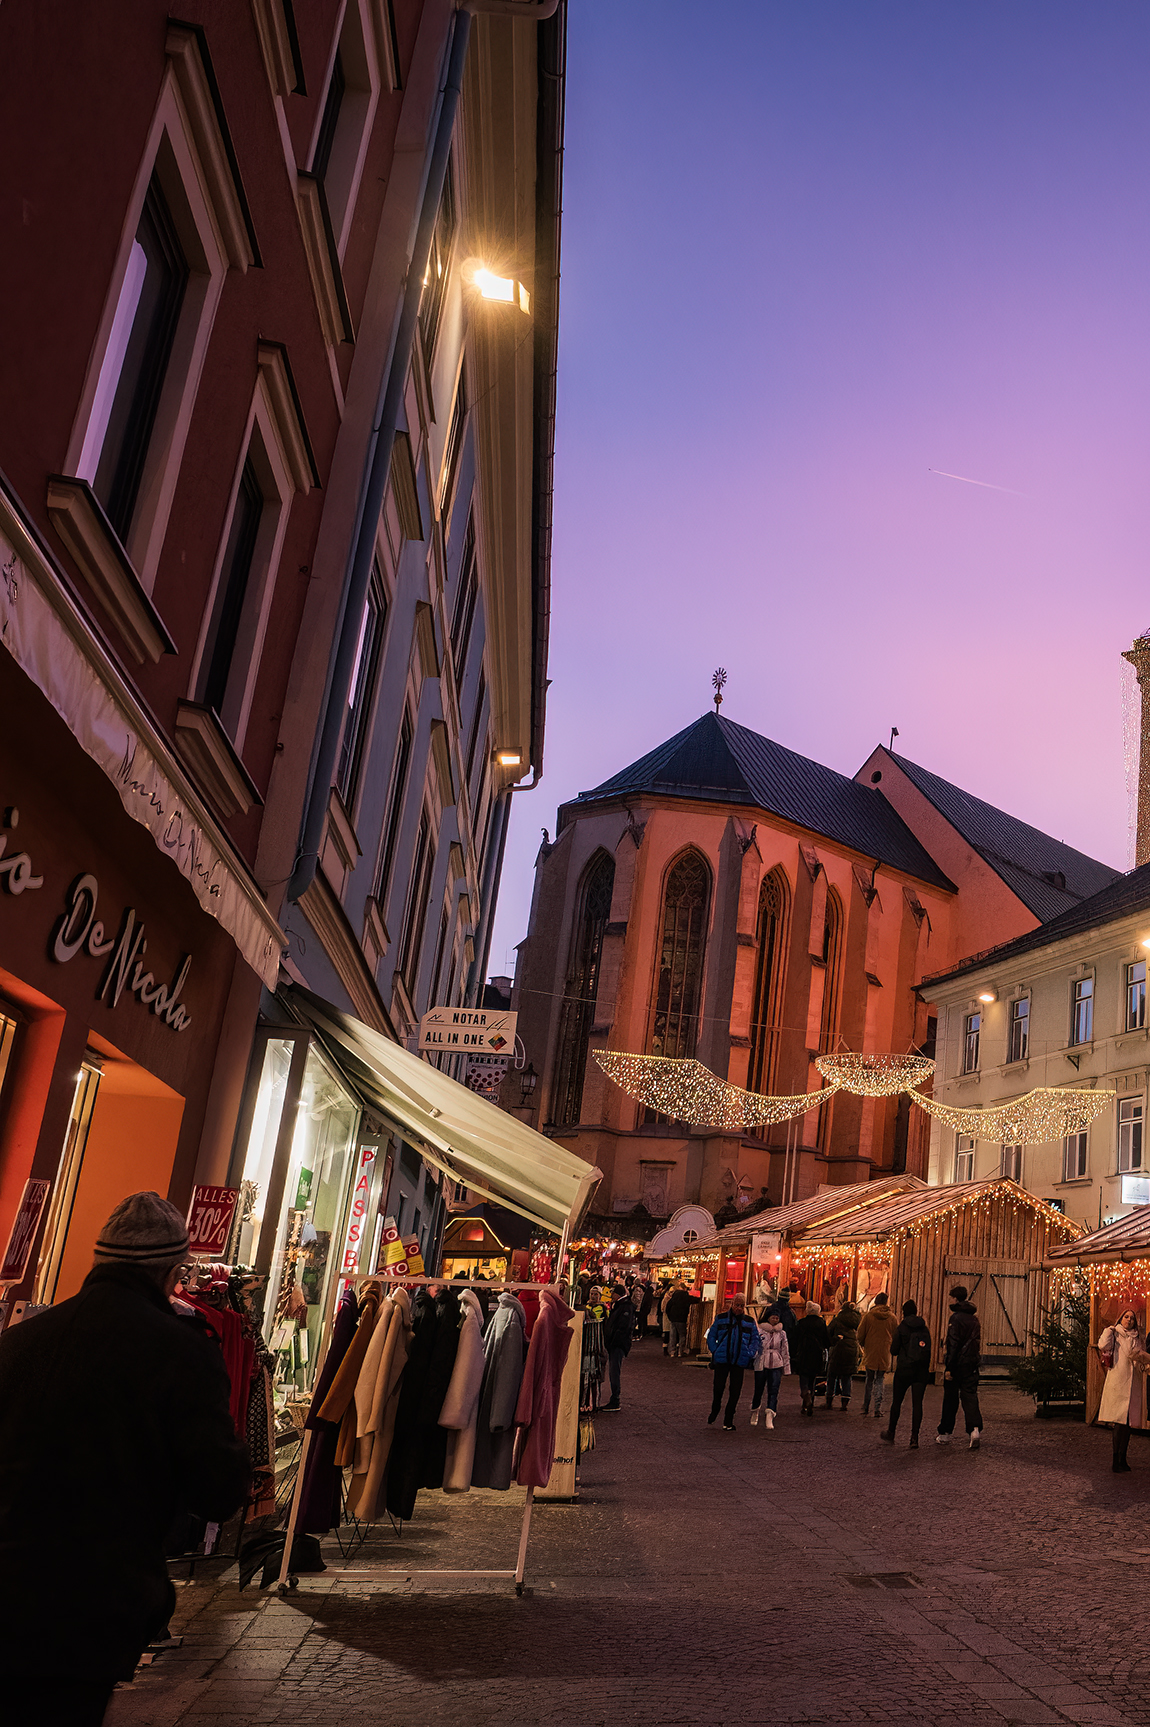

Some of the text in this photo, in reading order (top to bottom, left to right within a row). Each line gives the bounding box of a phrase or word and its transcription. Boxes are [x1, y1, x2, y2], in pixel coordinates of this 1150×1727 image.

[54, 873, 115, 964] De
[99, 907, 192, 1033] Nicola
[452, 1012, 487, 1025] NOTAR
[425, 1031, 485, 1046] ALL IN ONE
[195, 1188, 237, 1204] ALLES
[189, 1206, 232, 1245] -30%
